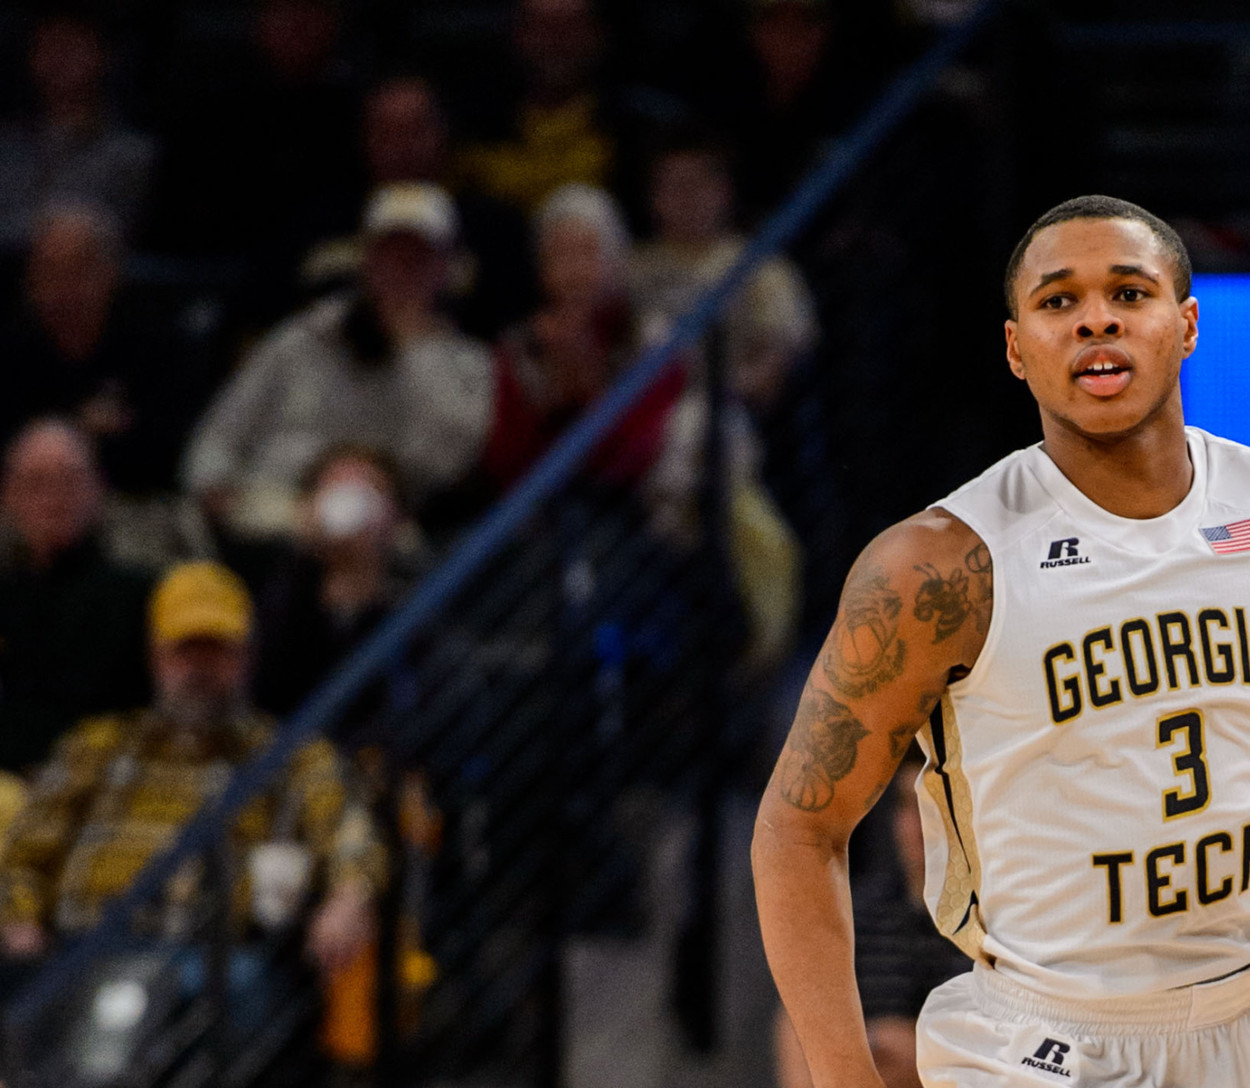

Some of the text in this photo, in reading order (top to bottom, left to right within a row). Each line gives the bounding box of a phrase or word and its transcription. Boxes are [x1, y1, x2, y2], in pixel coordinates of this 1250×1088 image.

[1040, 556, 1091, 569] RUSSELL
[1155, 706, 1212, 823] 3
[1021, 1056, 1071, 1078] RUSSELL
